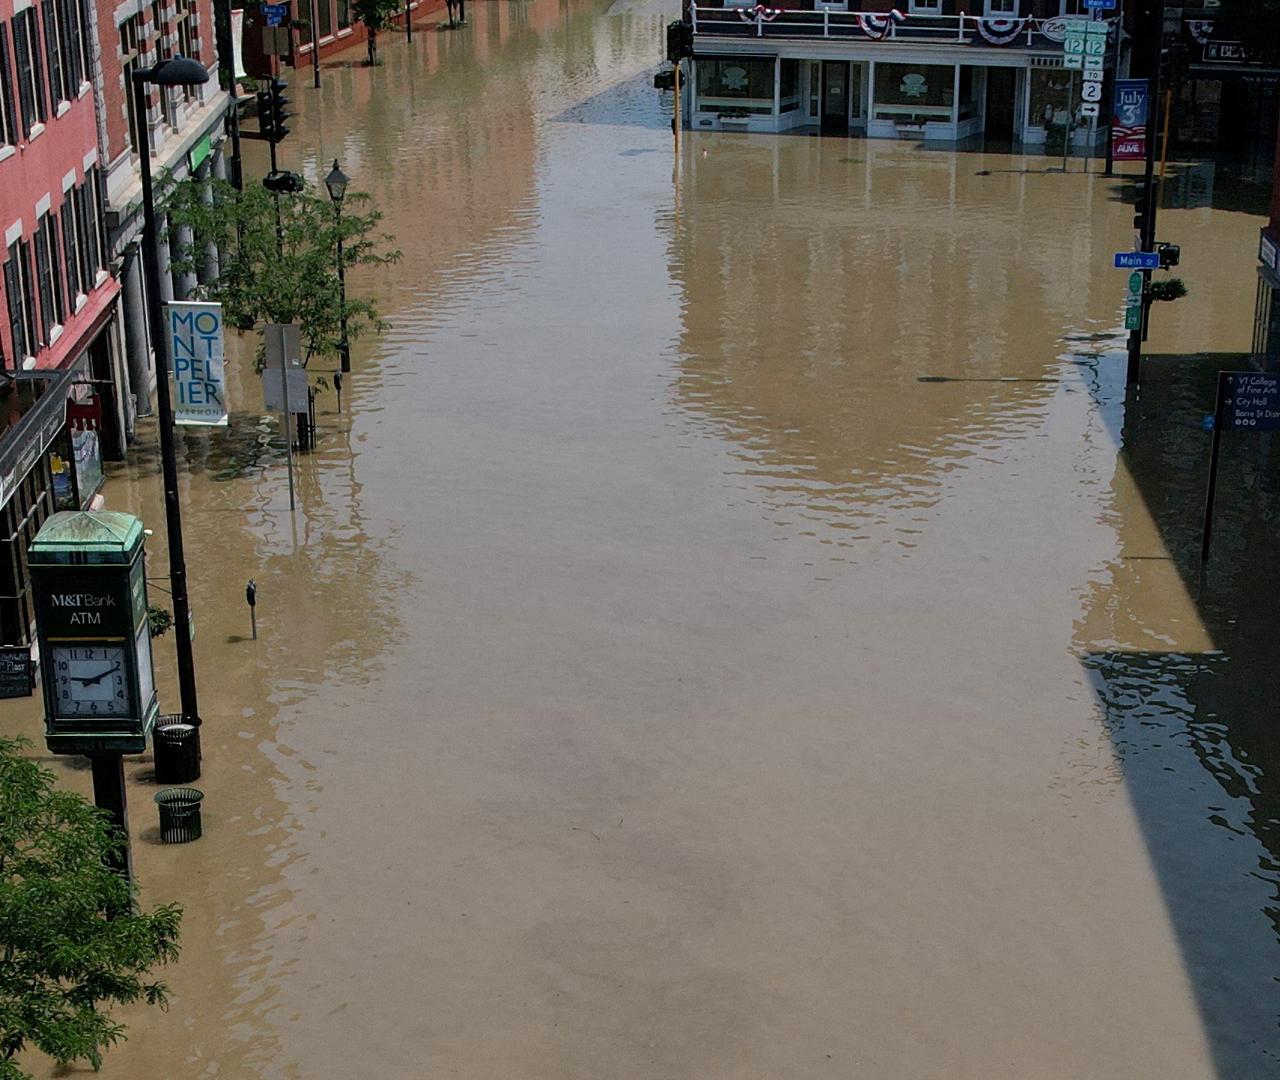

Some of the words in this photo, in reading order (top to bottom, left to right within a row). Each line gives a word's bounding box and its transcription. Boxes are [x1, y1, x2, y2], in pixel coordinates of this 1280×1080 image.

[1068, 40, 1080, 53] 12
[1090, 41, 1102, 54] 12
[1087, 86, 1096, 98] 2
[1117, 90, 1145, 106] July
[1120, 256, 1142, 265] Main
[172, 311, 218, 335] MO
[174, 335, 218, 358] NT
[174, 358, 220, 382] PEL
[180, 382, 222, 404] IER
[51, 593, 84, 607] M&T
[84, 592, 117, 607] Bank
[70, 612, 102, 625] ATM
